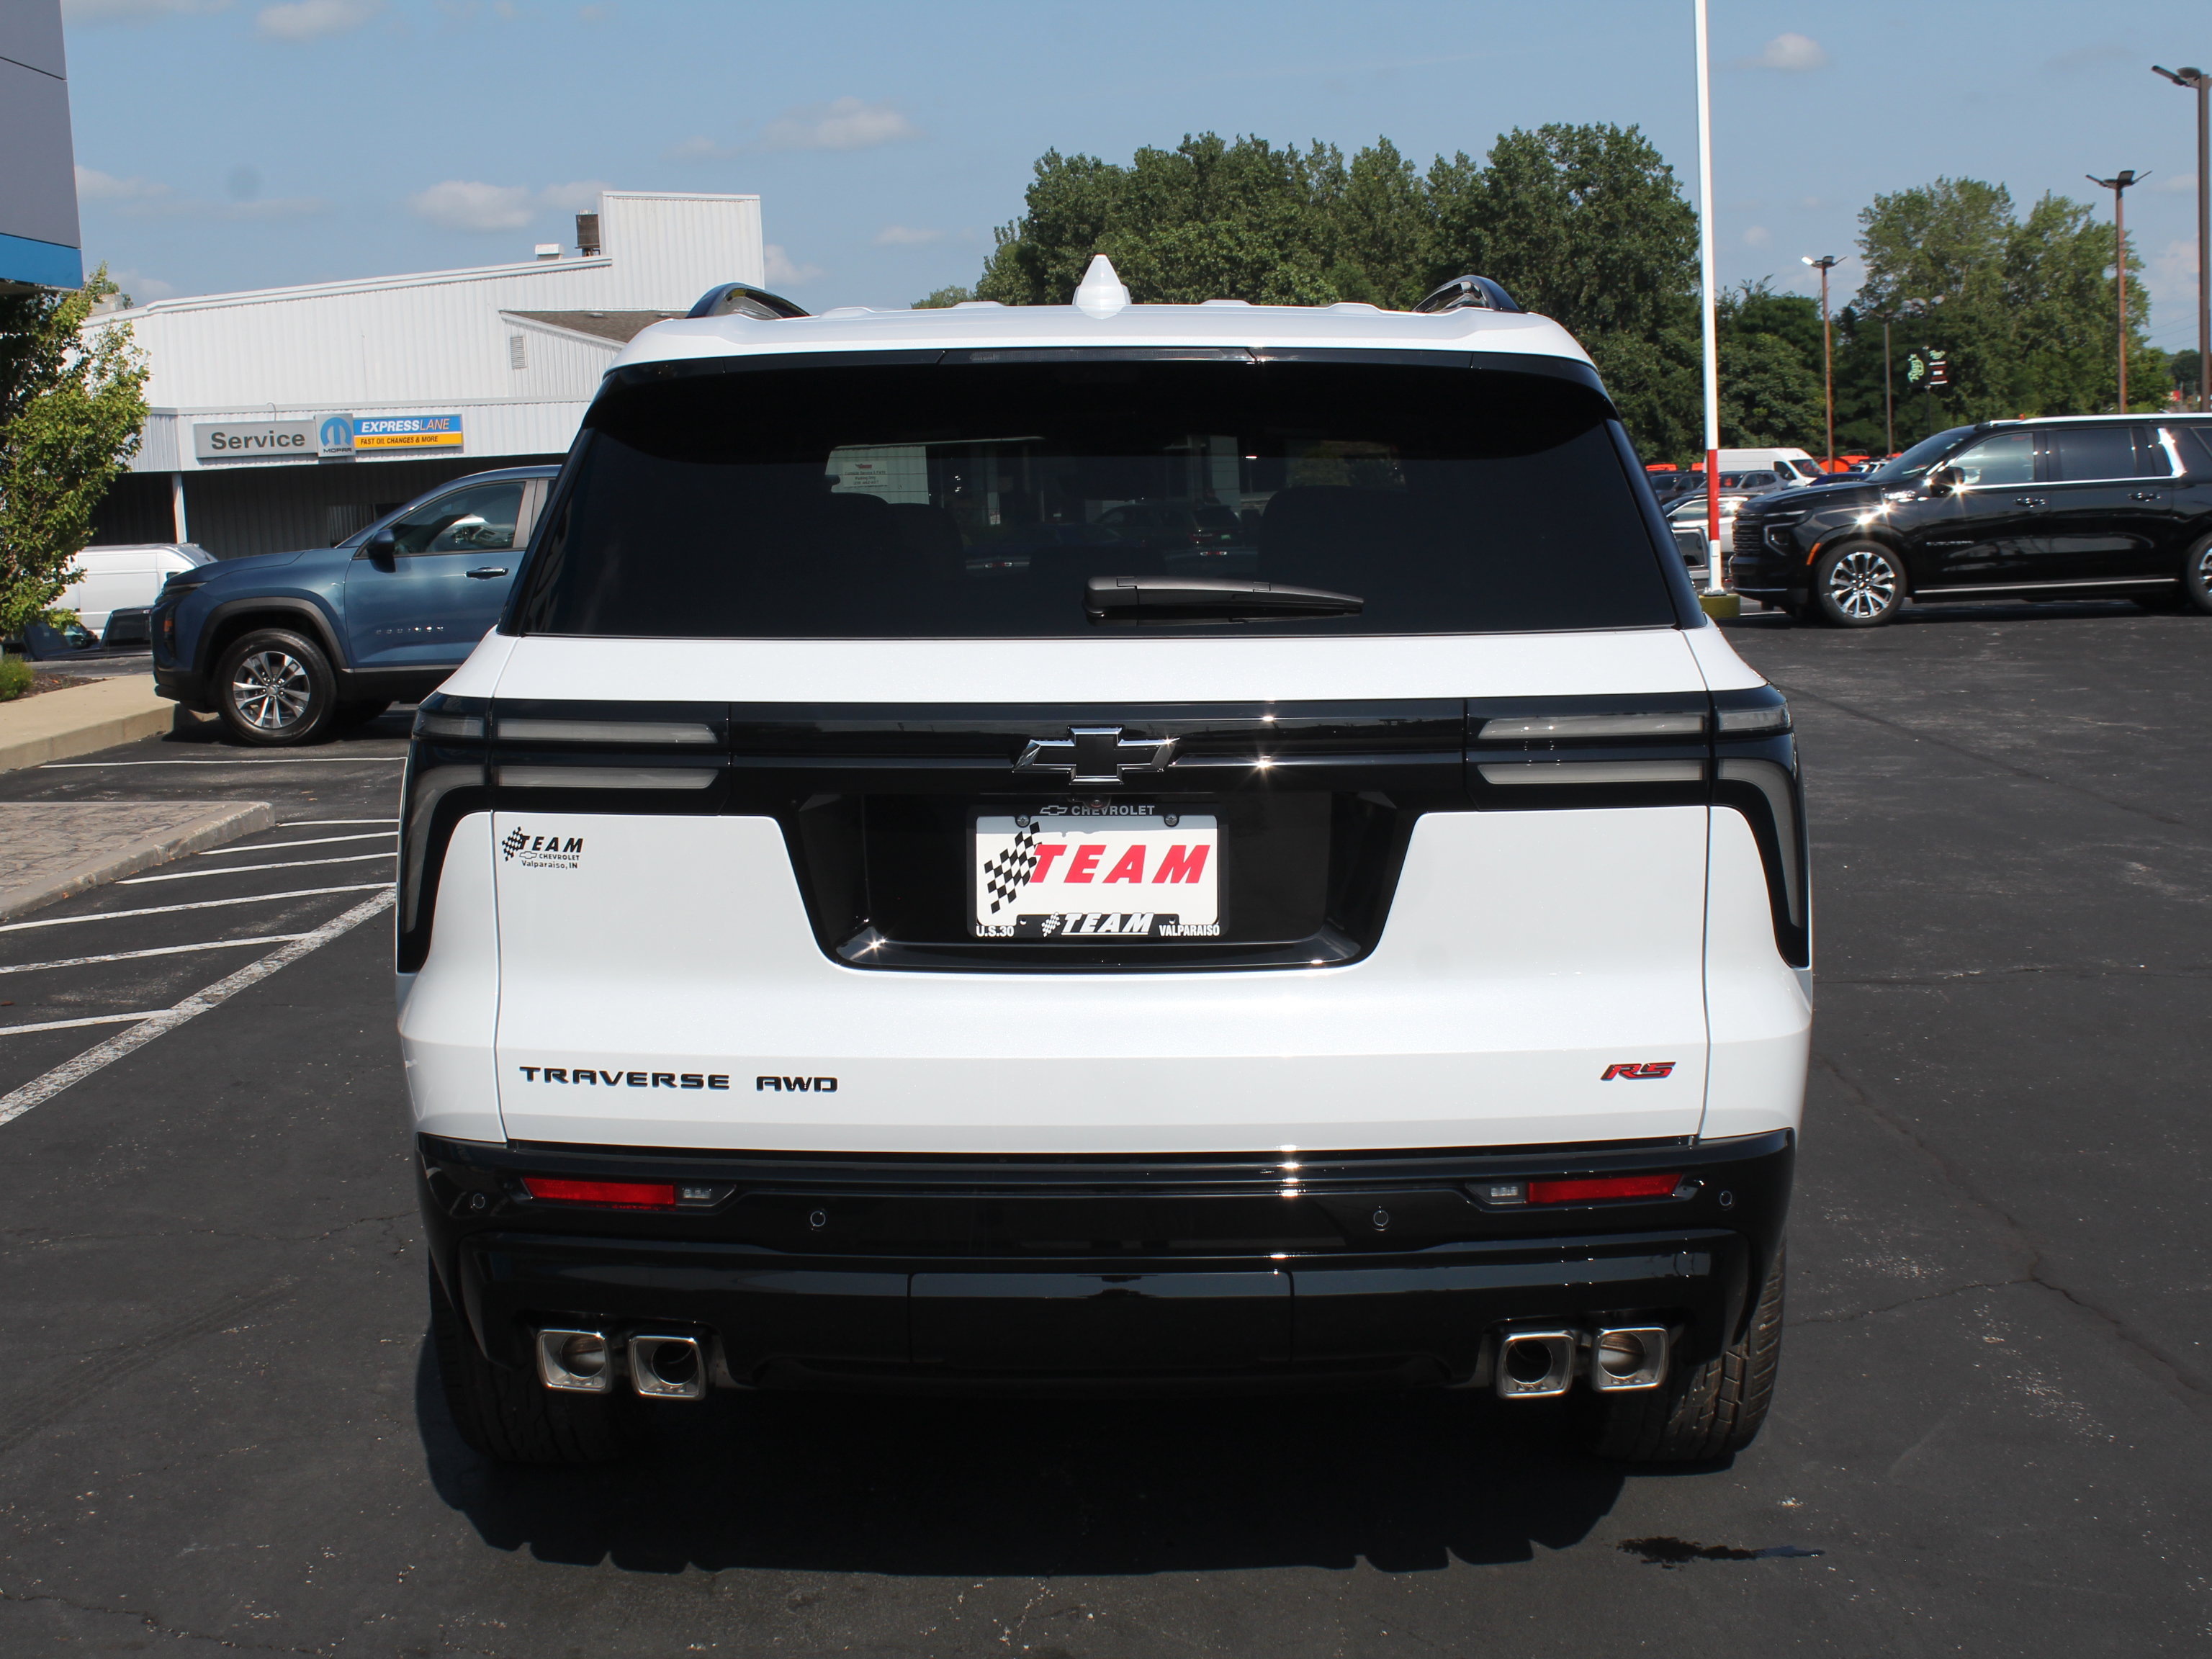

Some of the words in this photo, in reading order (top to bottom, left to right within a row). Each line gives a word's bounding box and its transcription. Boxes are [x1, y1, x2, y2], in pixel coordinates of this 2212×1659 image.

[211, 430, 305, 450] Service
[1071, 805, 1155, 816] CHEVROLET
[518, 835, 583, 853] TEAM
[521, 860, 567, 870] Valparaiso,
[1029, 844, 1211, 884] TEAM
[1061, 913, 1154, 933] TEAM
[1159, 925, 1220, 936] VALPARAISO
[519, 1066, 729, 1089] TRAVERSE
[756, 1076, 838, 1093] AWD
[1600, 1061, 1676, 1081] RS
